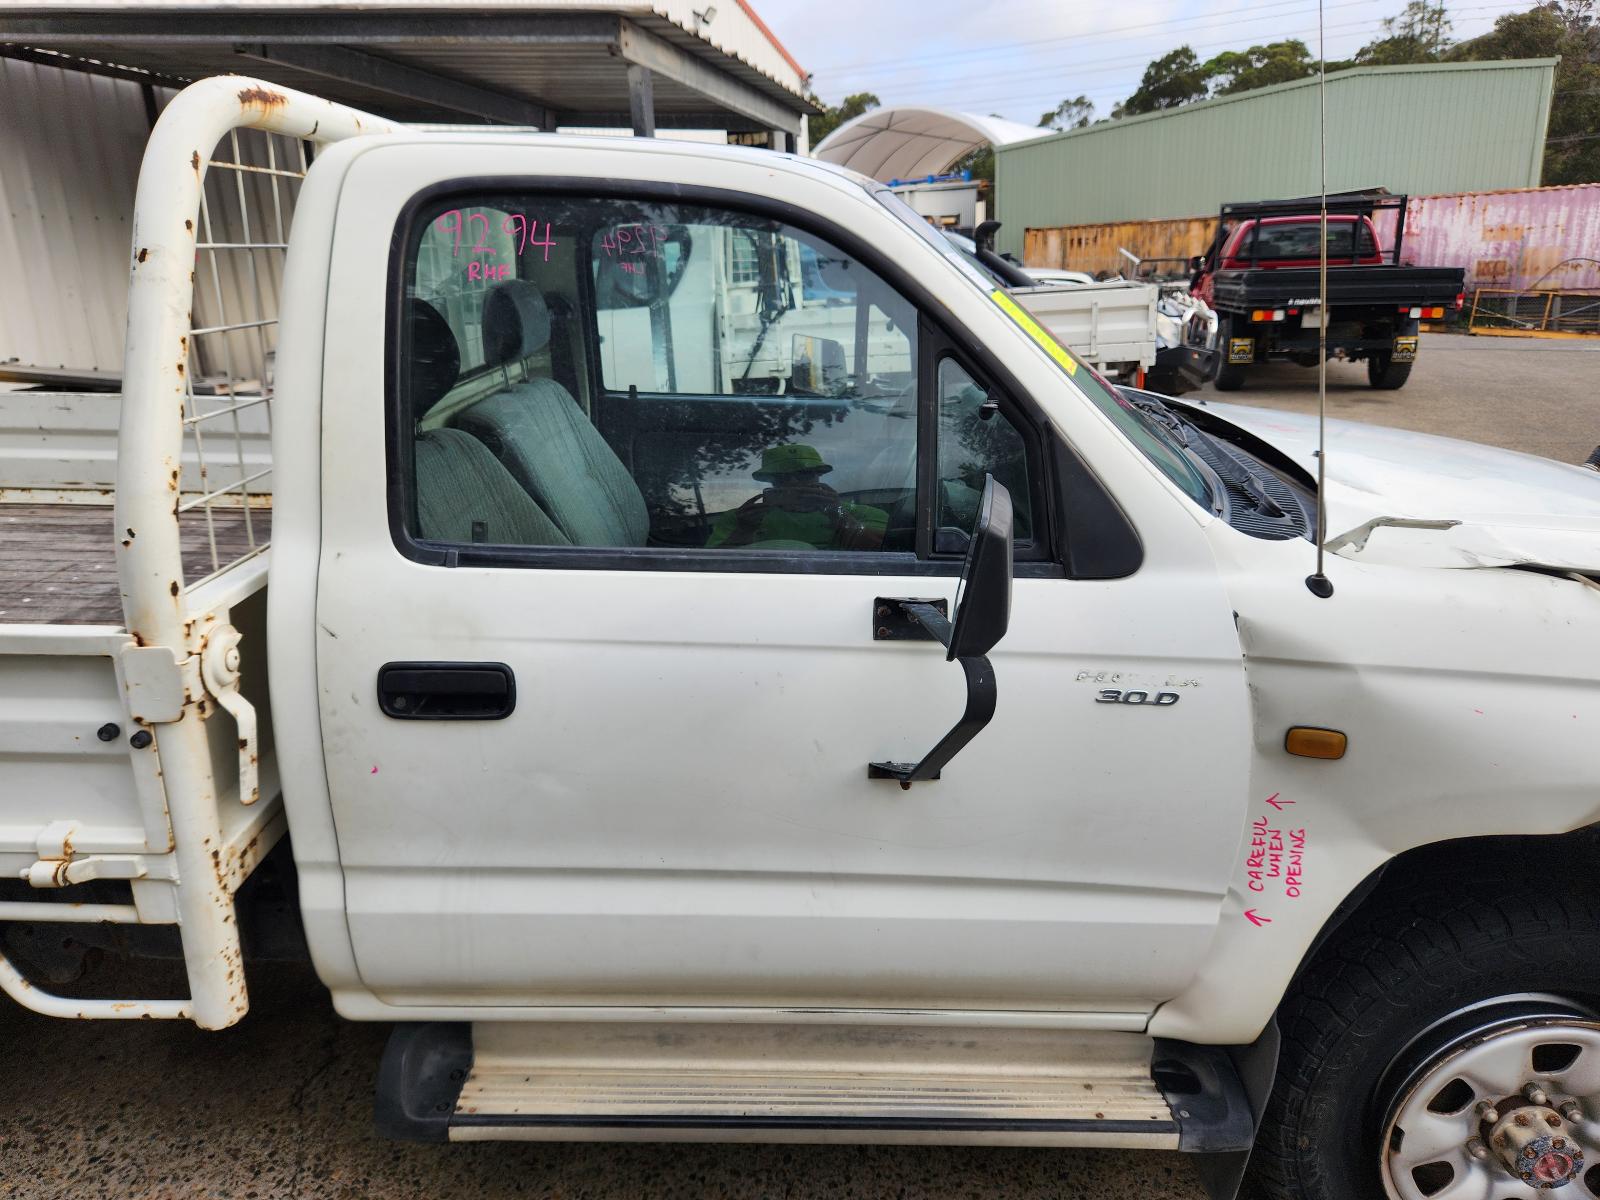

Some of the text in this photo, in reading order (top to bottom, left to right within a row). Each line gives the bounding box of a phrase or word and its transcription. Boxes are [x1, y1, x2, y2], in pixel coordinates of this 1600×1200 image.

[435, 209, 556, 262] 9294
[467, 262, 511, 282] RHF
[1246, 815, 1269, 892] CAREFUL
[1266, 829, 1284, 877] WHEN
[1285, 828, 1306, 898] OPENING
